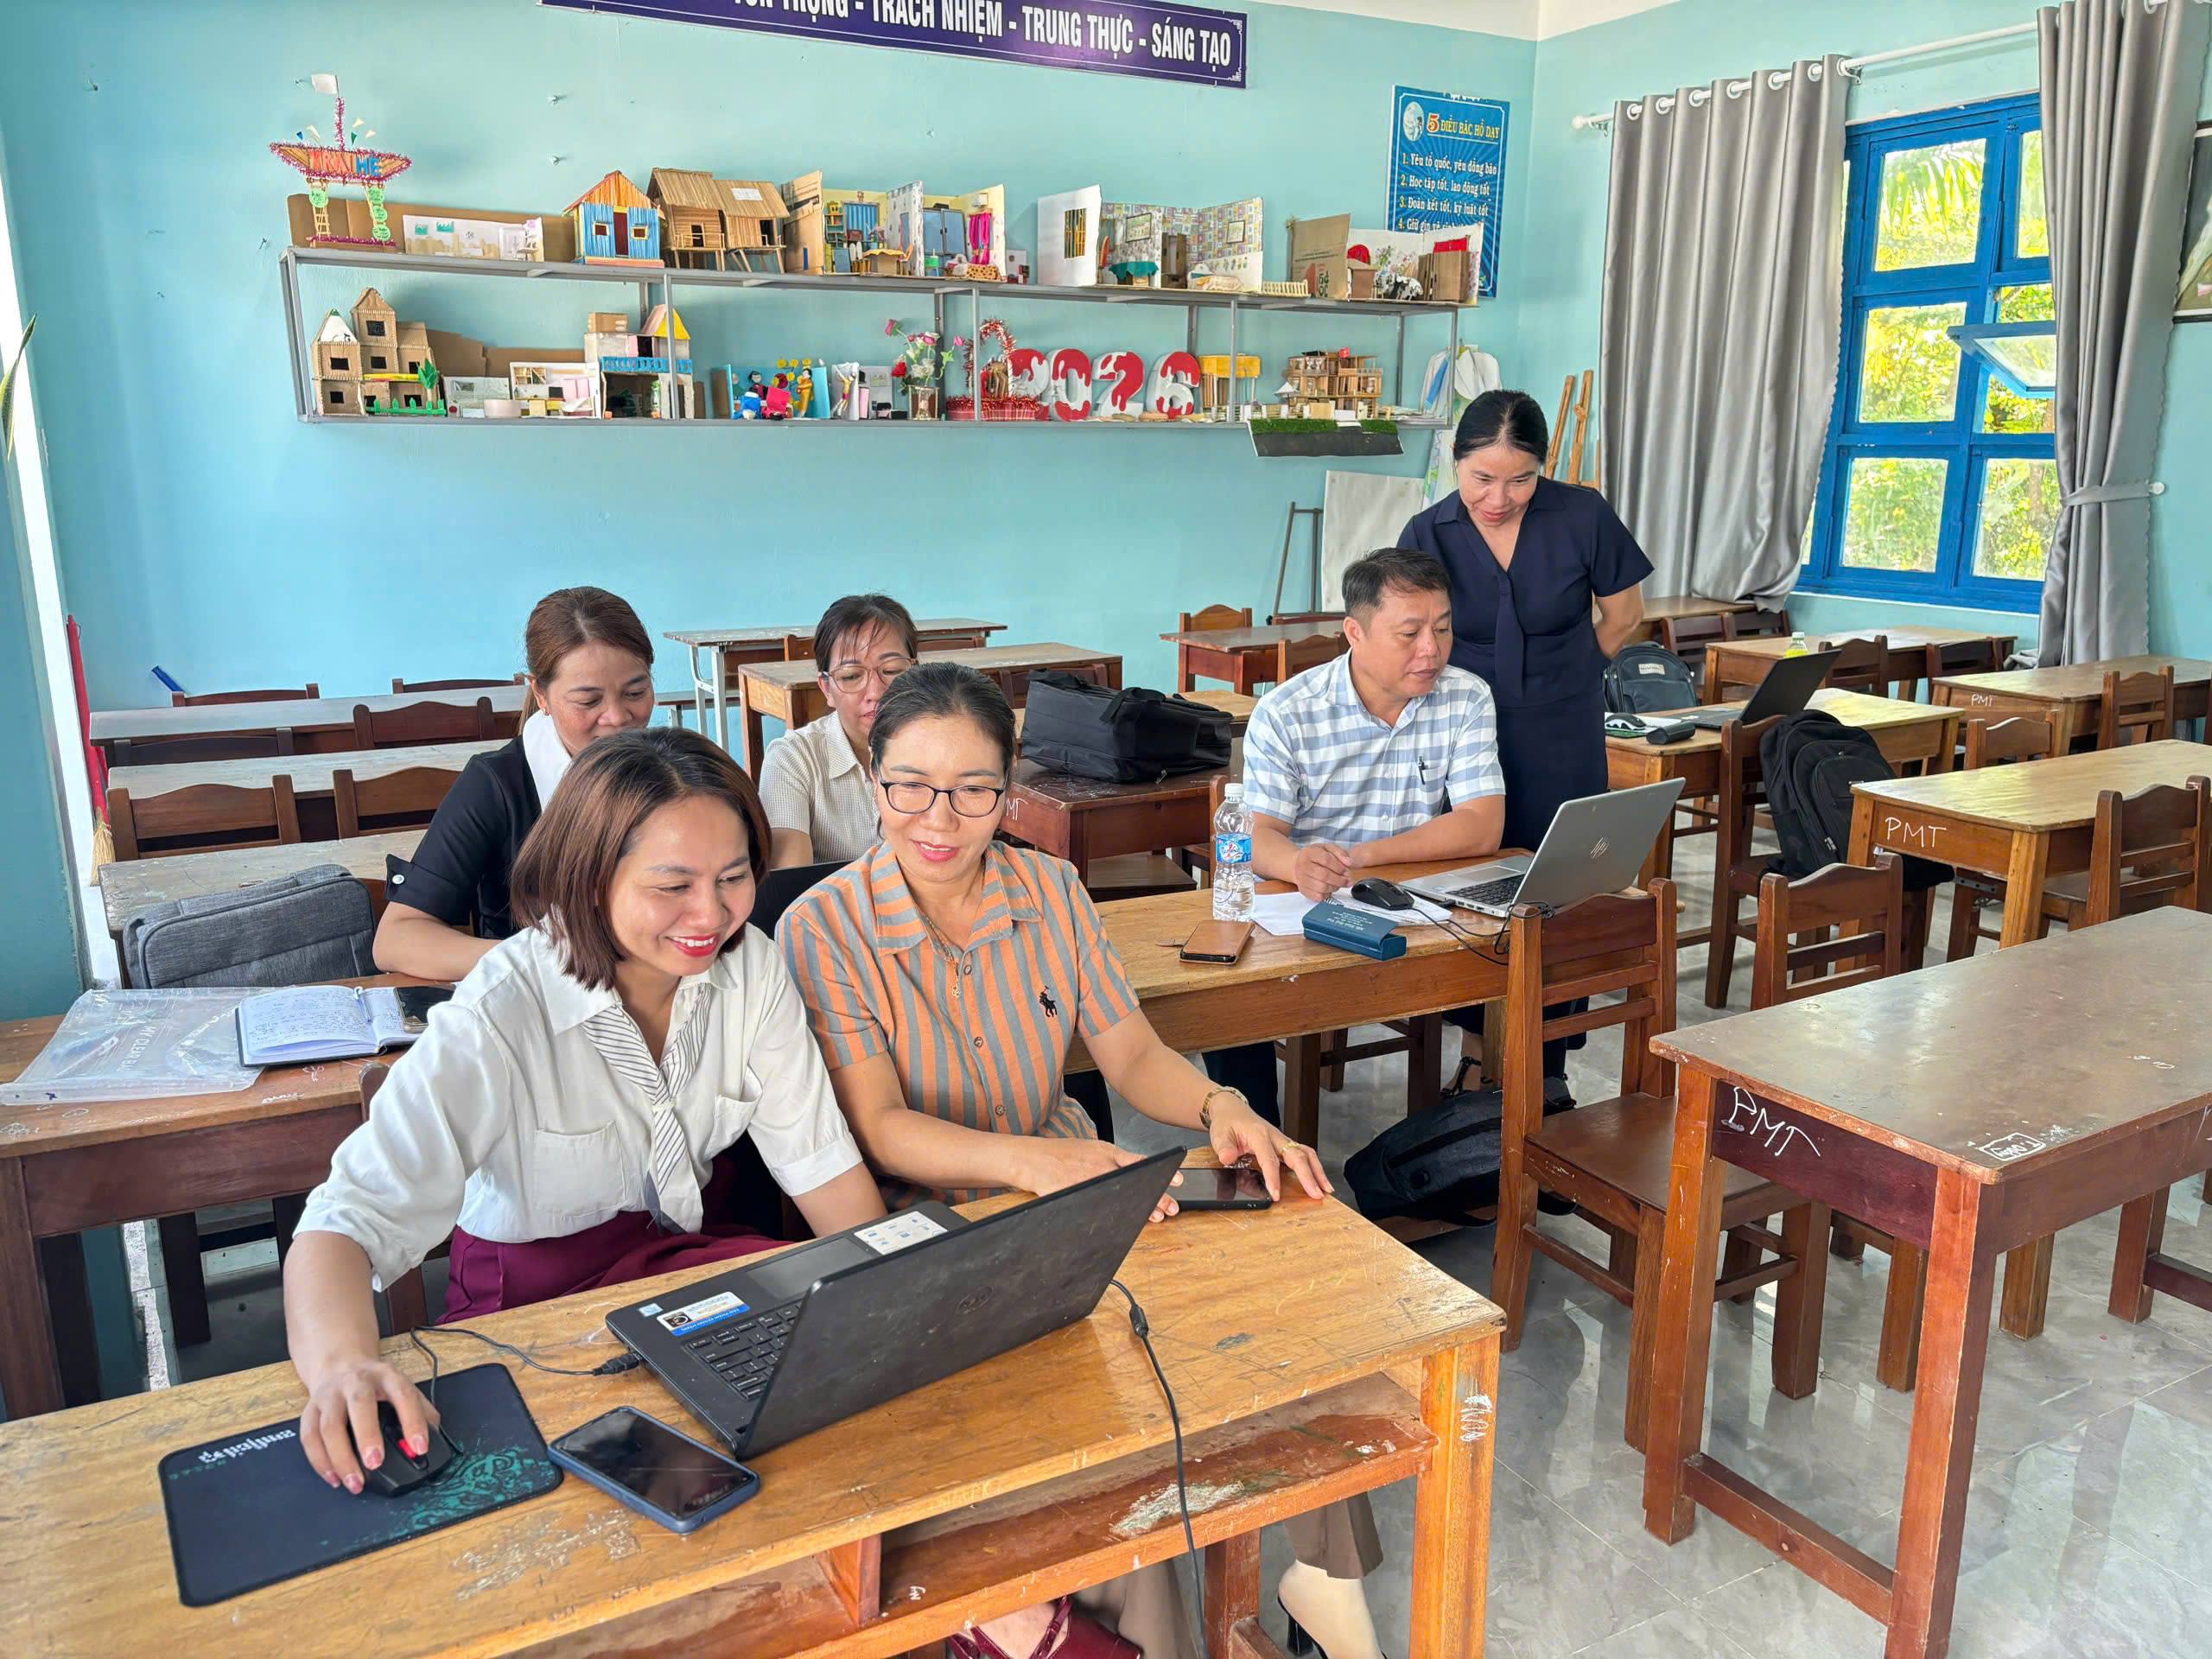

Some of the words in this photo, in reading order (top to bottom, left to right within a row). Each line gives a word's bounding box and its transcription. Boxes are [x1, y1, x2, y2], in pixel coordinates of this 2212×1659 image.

[1021, 5, 1082, 48] TRUNG
[1086, 13, 1134, 60] THỰC
[1151, 16, 1195, 61] SÁNG
[1199, 29, 1231, 73] TẠO
[1427, 112, 1440, 133] 5
[1459, 119, 1473, 137] BÁC
[1402, 152, 1409, 165] 1.
[1410, 153, 1425, 166] Yêu
[1434, 155, 1452, 171] quốc,
[1454, 159, 1467, 173] yêu
[1400, 174, 1408, 187] 2.
[1451, 180, 1461, 192] lao
[1479, 181, 1491, 196] tốt
[1400, 195, 1407, 208] 3.
[1427, 197, 1439, 211] kết
[1478, 202, 1489, 217] tốt
[1972, 694, 1998, 707] PMT
[1007, 798, 1029, 821] MT
[1885, 817, 1948, 848] PMT
[1728, 1086, 1821, 1157] PMT
